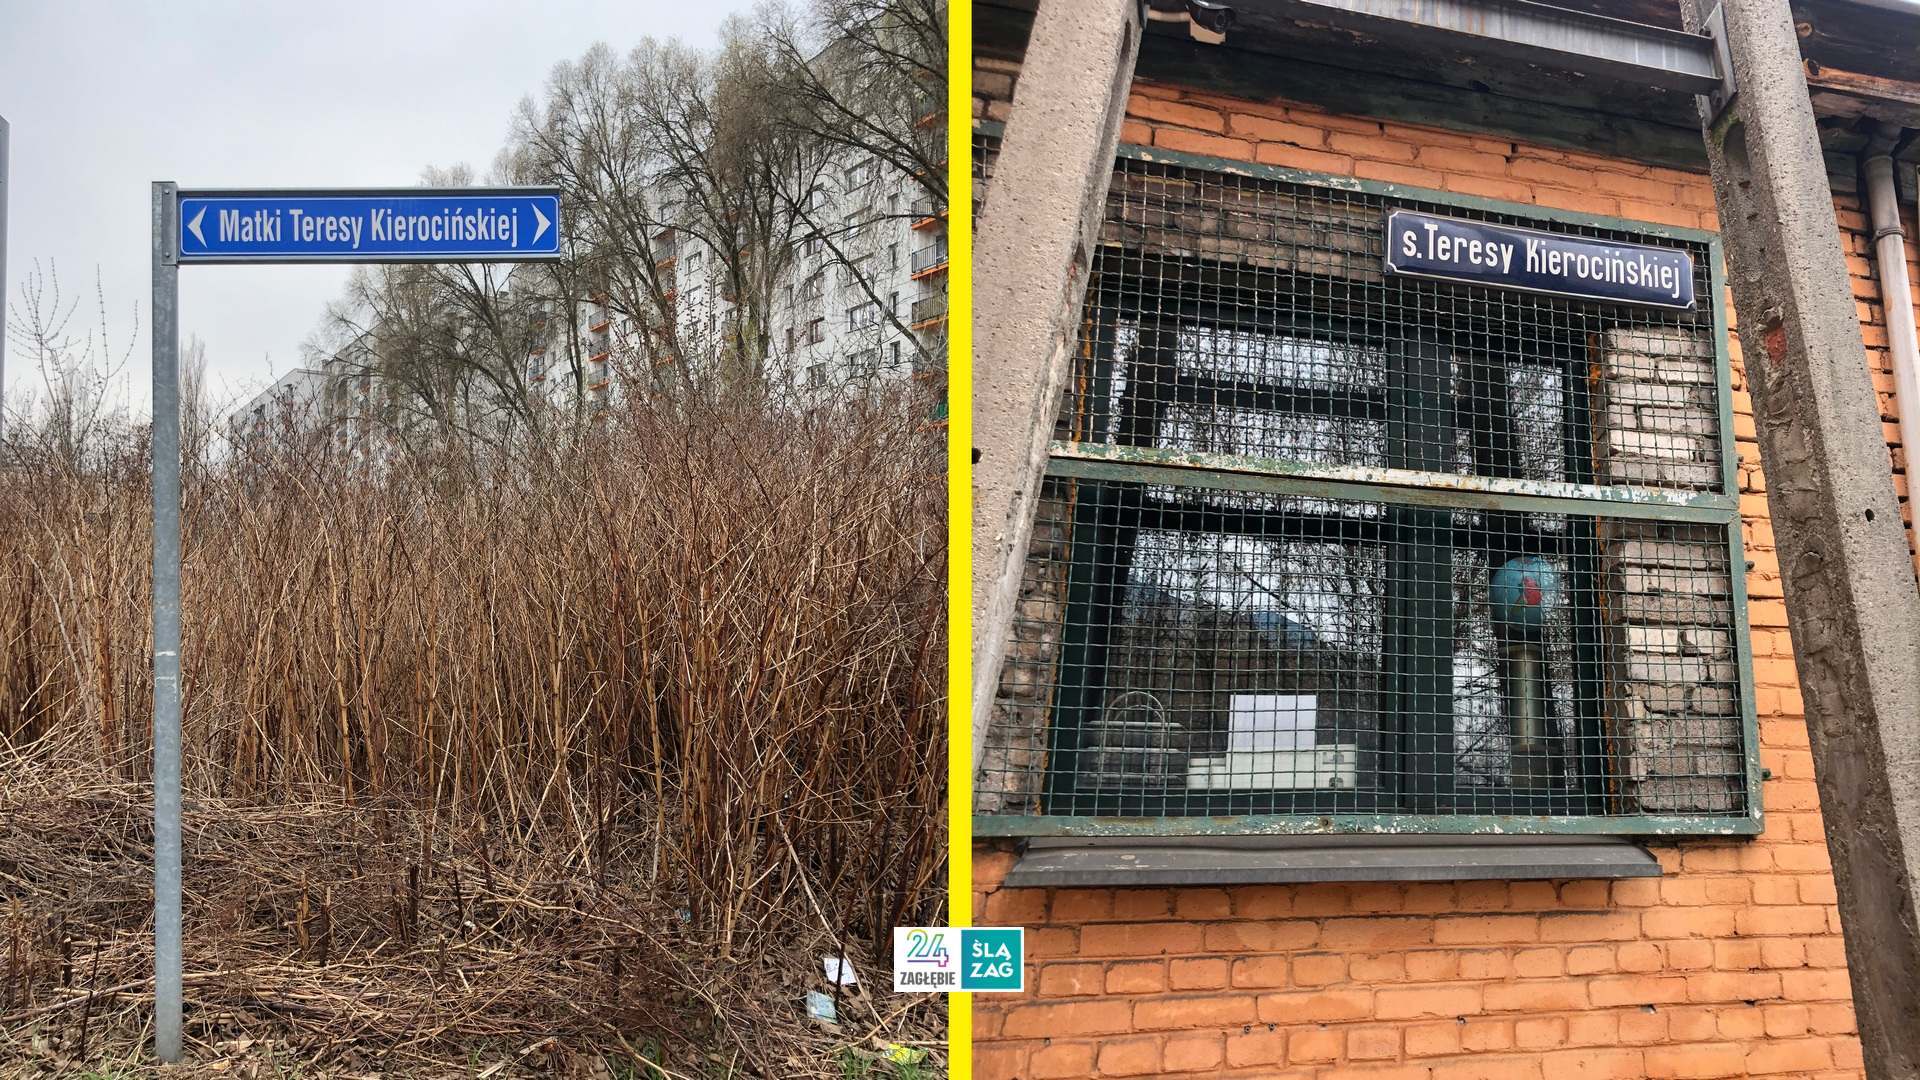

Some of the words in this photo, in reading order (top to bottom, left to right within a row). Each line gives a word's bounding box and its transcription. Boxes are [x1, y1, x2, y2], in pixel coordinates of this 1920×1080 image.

[219, 208, 281, 242] Matki
[289, 209, 363, 249] Teresy
[371, 207, 518, 248] Kierocińskiej
